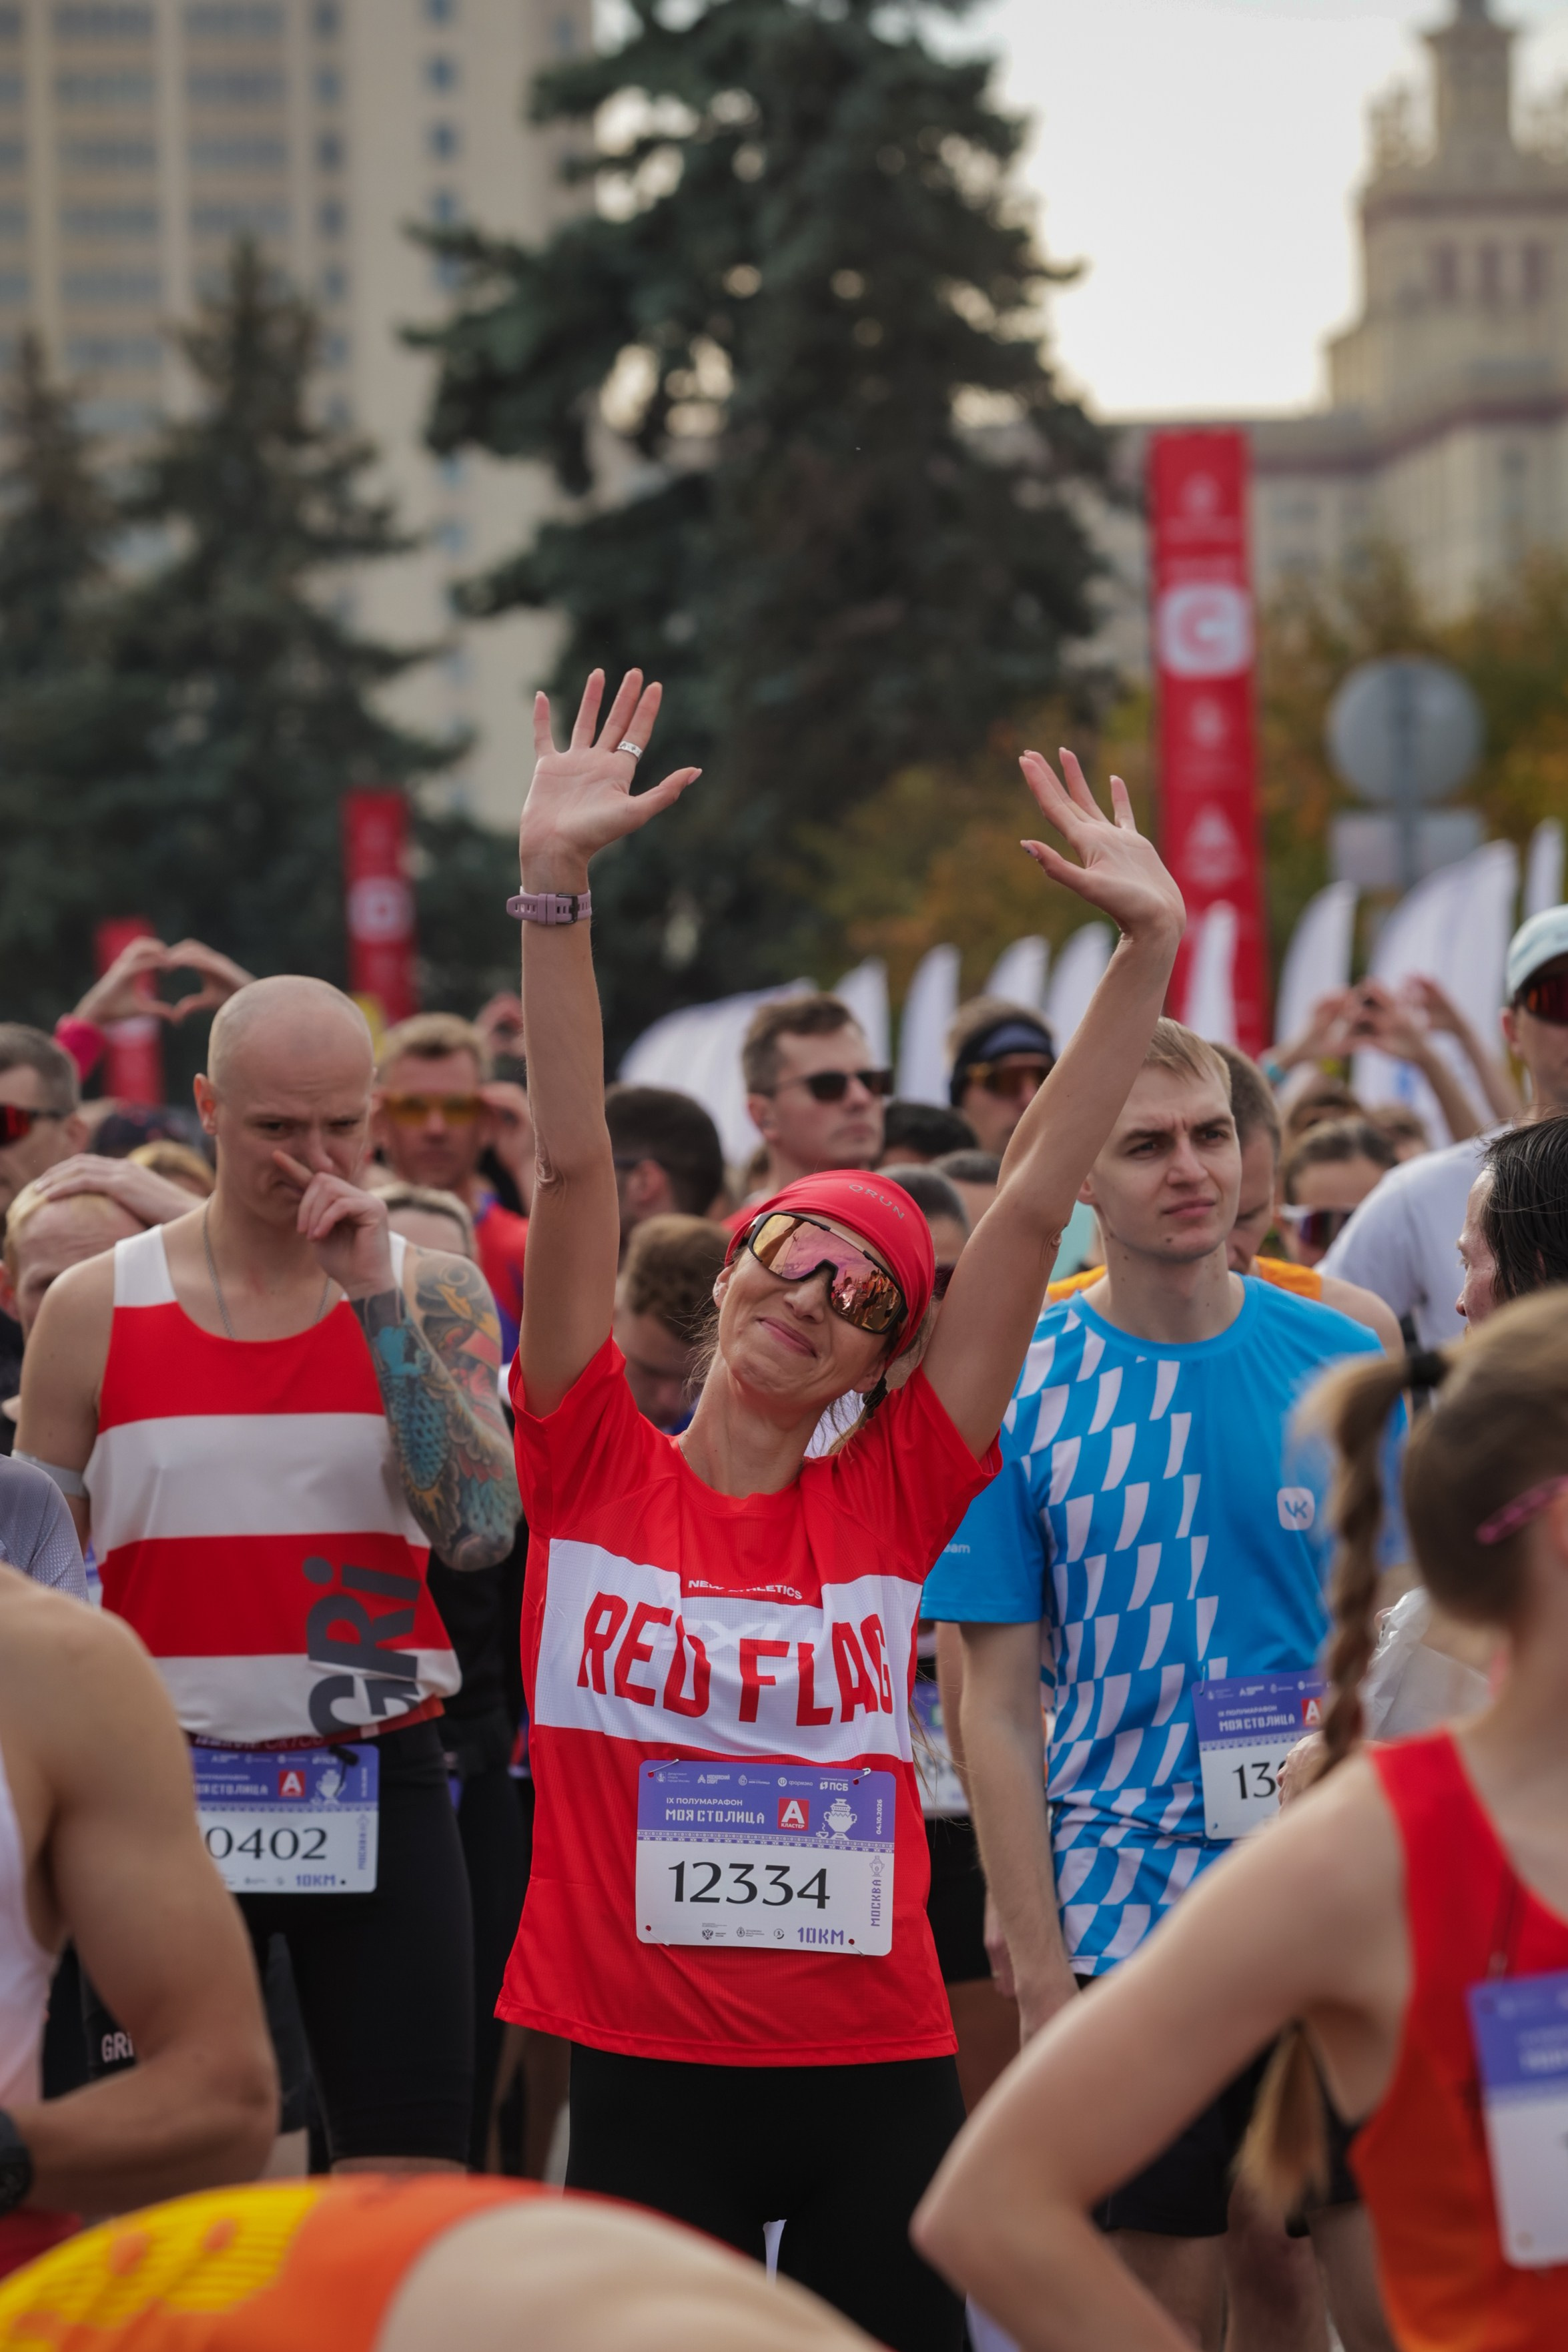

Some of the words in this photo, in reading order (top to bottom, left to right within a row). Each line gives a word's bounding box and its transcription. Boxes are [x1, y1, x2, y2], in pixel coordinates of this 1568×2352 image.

[849, 1184, 905, 1219] QRUN
[1284, 1500, 1308, 1519] VK
[577, 1591, 711, 1718] RED
[739, 1613, 893, 1727] FLAG
[1220, 1717, 1242, 1732] МОЯ
[1244, 1713, 1296, 1730] СТОЛИЦА
[829, 1782, 849, 1792] ПСБ
[1233, 1761, 1286, 1800] 13
[665, 1809, 694, 1822] МОЯ
[697, 1810, 765, 1825] СТОЛИЦА
[676, 1798, 743, 1806] ПОЛУМАРАФОН
[205, 1826, 327, 1860] 0402
[668, 1860, 831, 1910] 12334
[870, 1879, 881, 1927] МОСКВА
